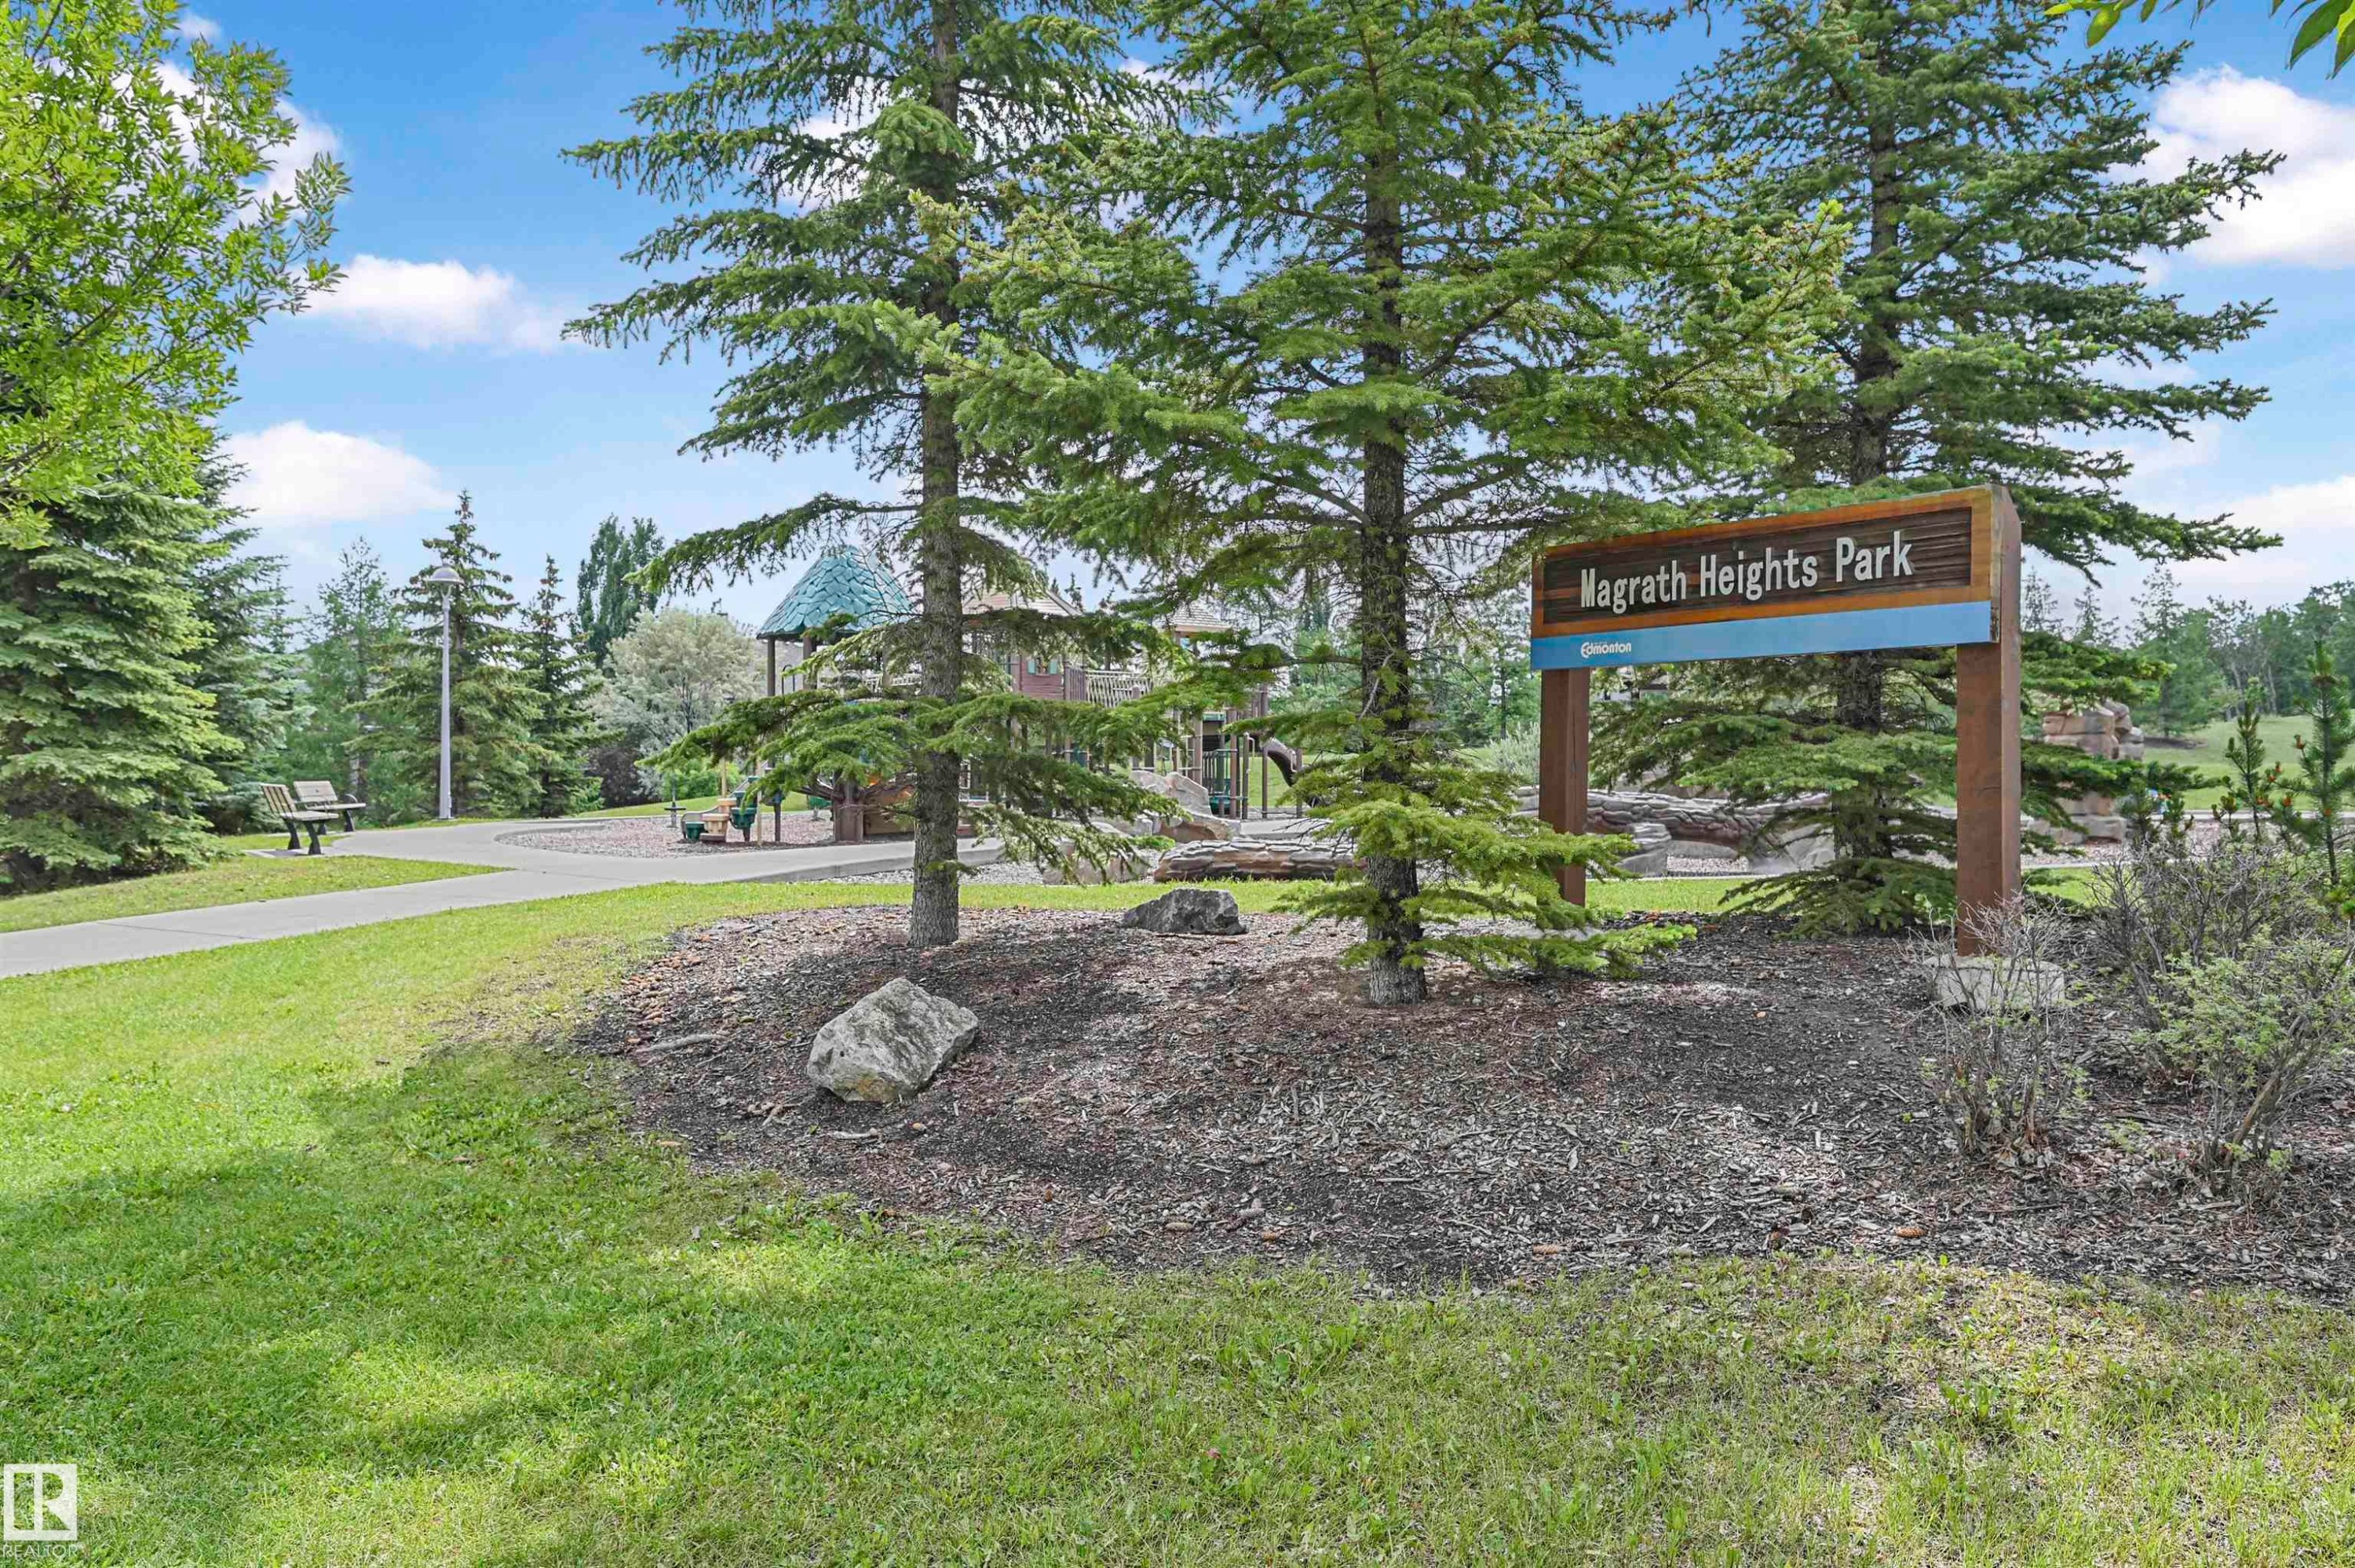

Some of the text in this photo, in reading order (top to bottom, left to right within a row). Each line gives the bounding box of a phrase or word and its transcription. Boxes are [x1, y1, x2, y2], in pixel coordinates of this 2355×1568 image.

[1581, 531, 1913, 614] Magrath Heights Park
[1580, 642, 1632, 658] Edmonton
